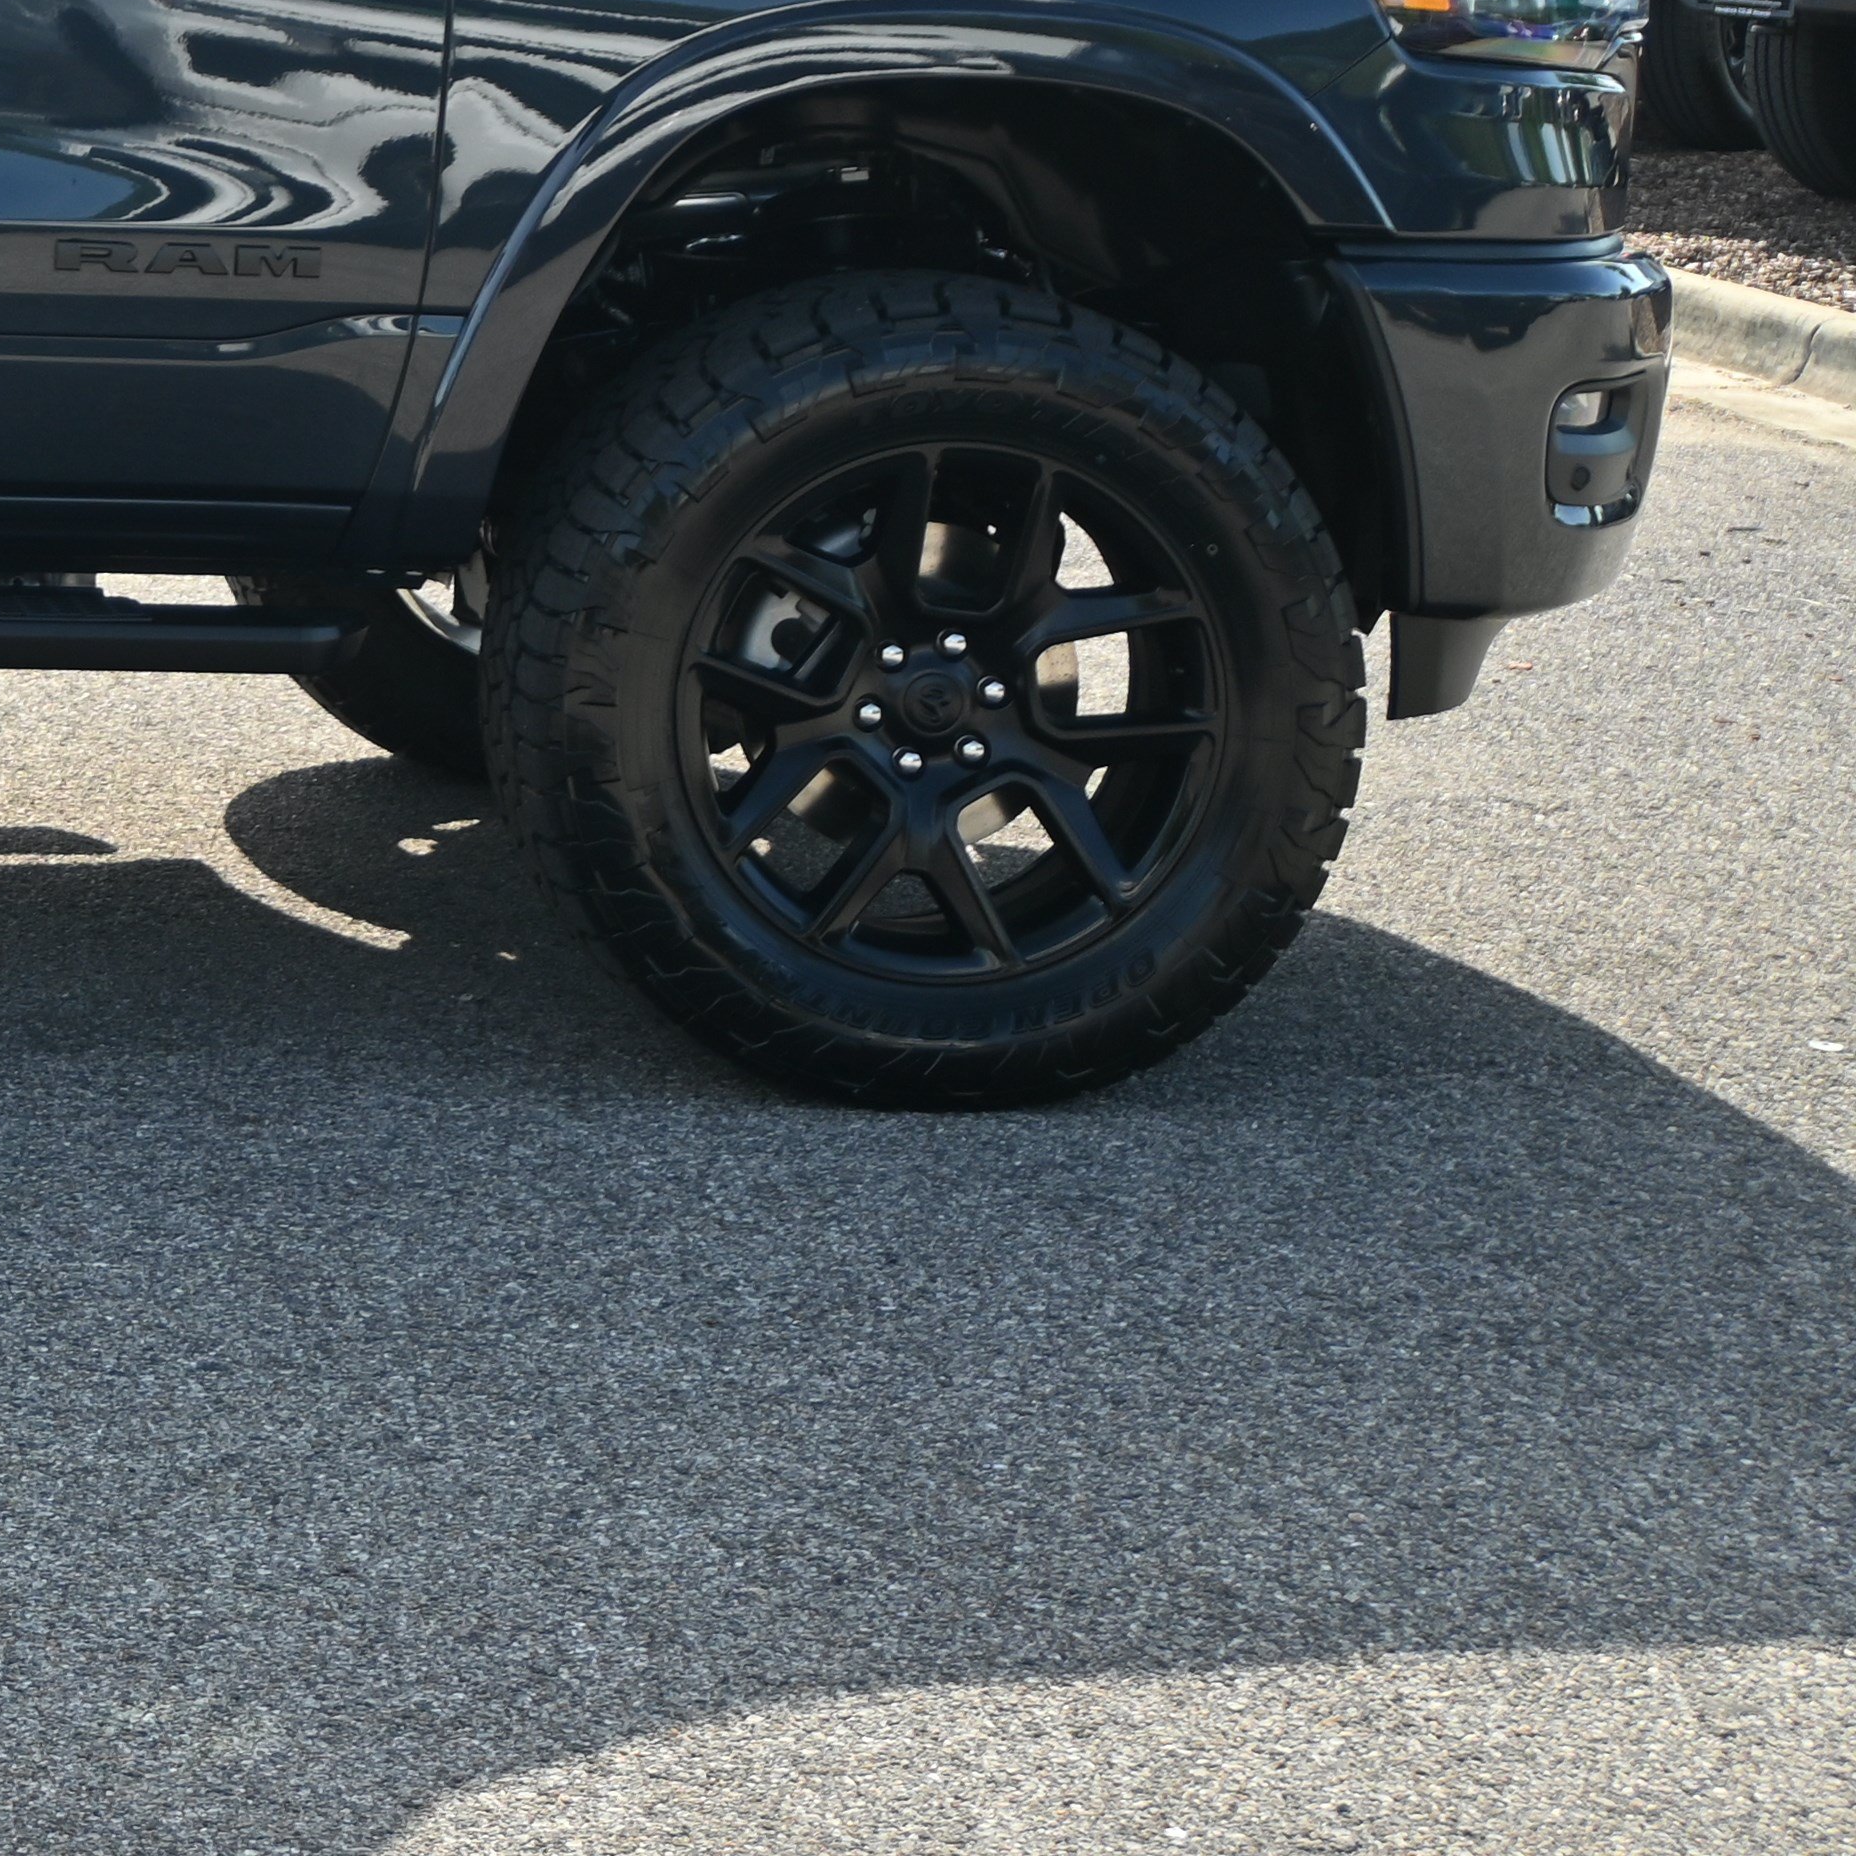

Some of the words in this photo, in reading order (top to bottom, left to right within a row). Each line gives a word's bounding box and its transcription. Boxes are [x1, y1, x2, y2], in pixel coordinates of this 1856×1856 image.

[53, 237, 322, 279] RAM
[851, 387, 1022, 428] TOYO
[728, 950, 992, 1041] COUNTR
[1012, 947, 1158, 1036] OPEN
